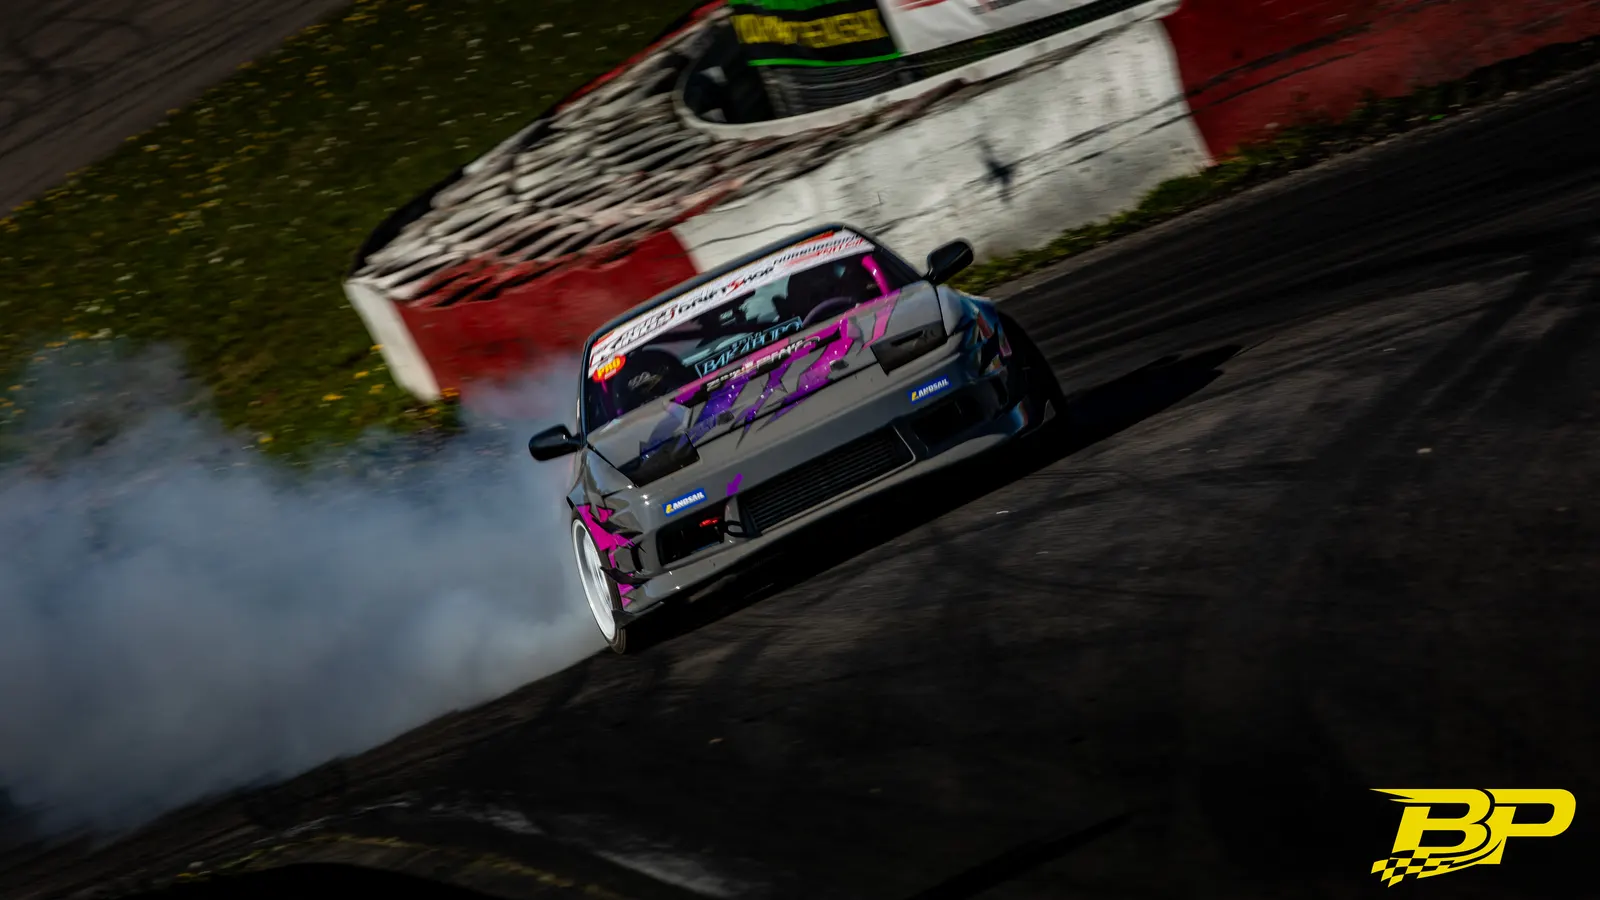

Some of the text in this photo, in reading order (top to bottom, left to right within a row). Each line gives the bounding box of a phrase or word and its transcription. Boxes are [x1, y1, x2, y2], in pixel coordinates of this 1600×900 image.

[597, 356, 621, 379] PRO
[911, 378, 949, 402] LANDSAIL
[665, 492, 706, 514] LANDSAIL
